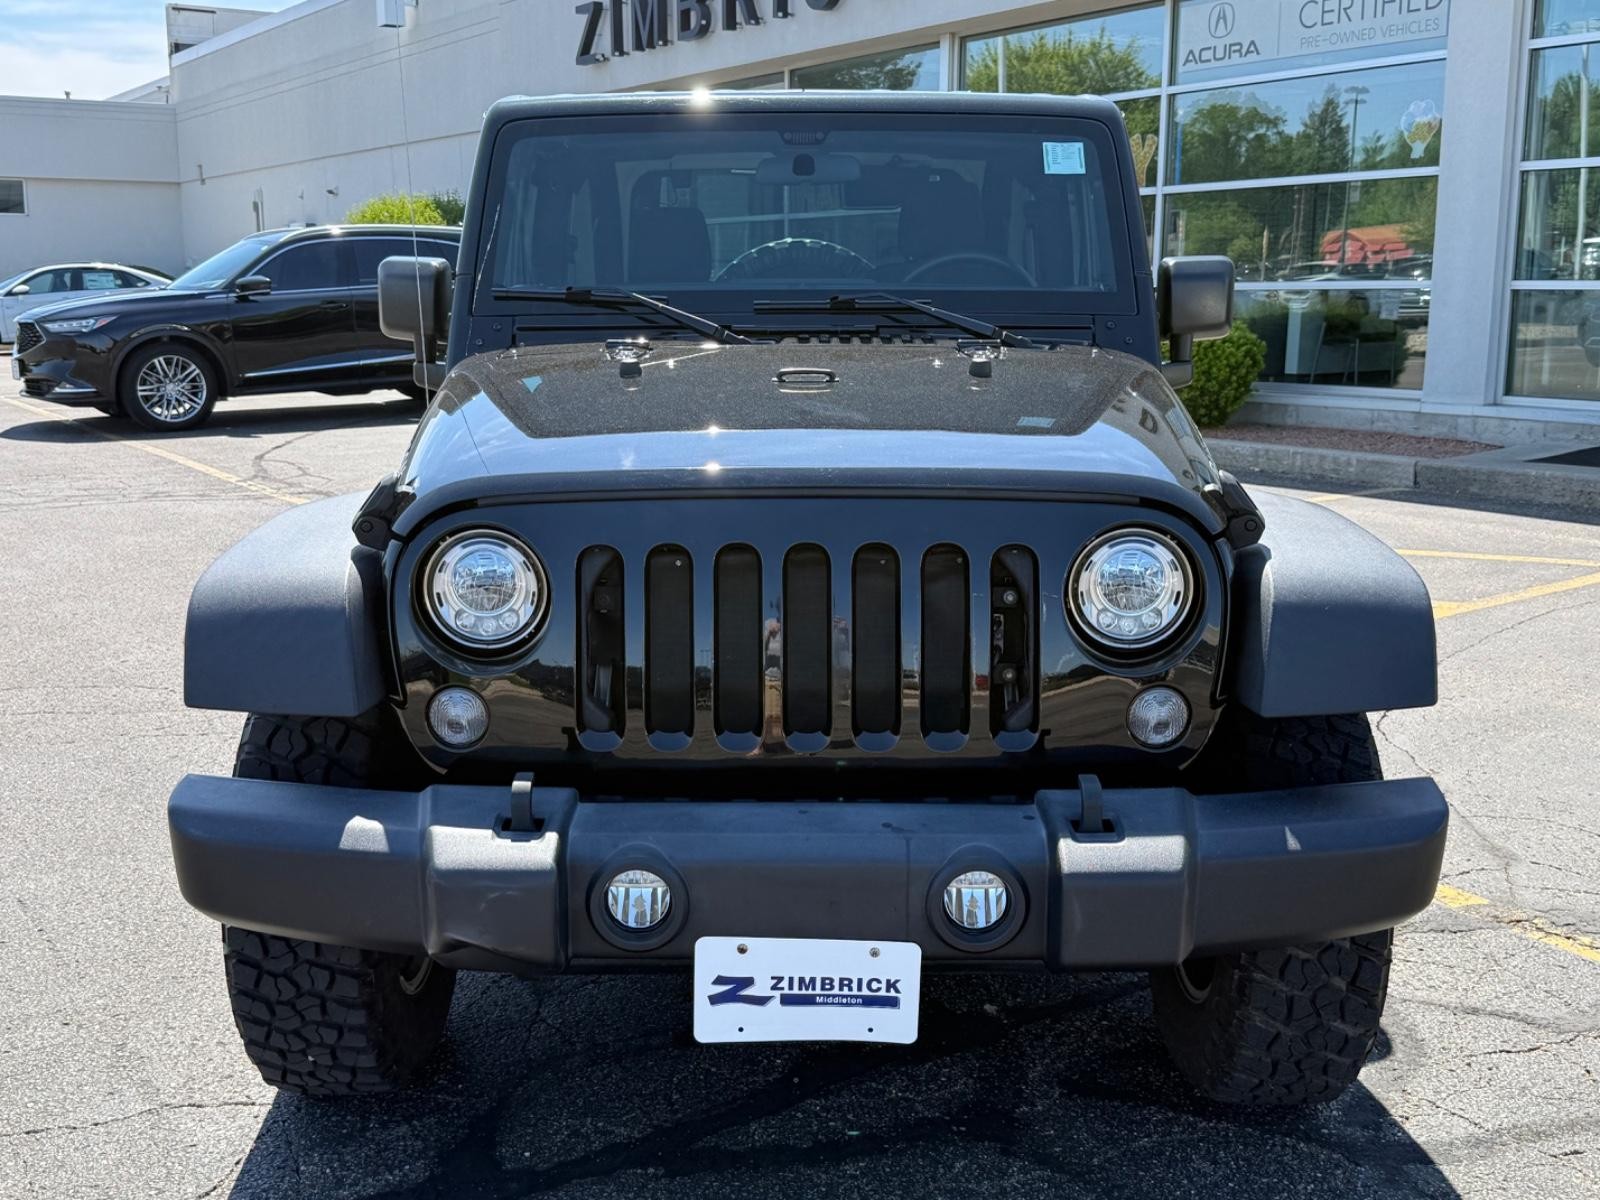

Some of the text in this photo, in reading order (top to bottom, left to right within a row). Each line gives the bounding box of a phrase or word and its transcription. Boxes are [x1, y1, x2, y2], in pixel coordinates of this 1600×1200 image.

[1299, 0, 1442, 28] CERTIF
[575, 0, 839, 65] ZIMB
[1300, 18, 1440, 48] PRE-OWNED VEHICLES
[1182, 40, 1260, 67] ACURA
[770, 976, 901, 994] ZIMBRICK
[815, 995, 863, 1005] Middleton
